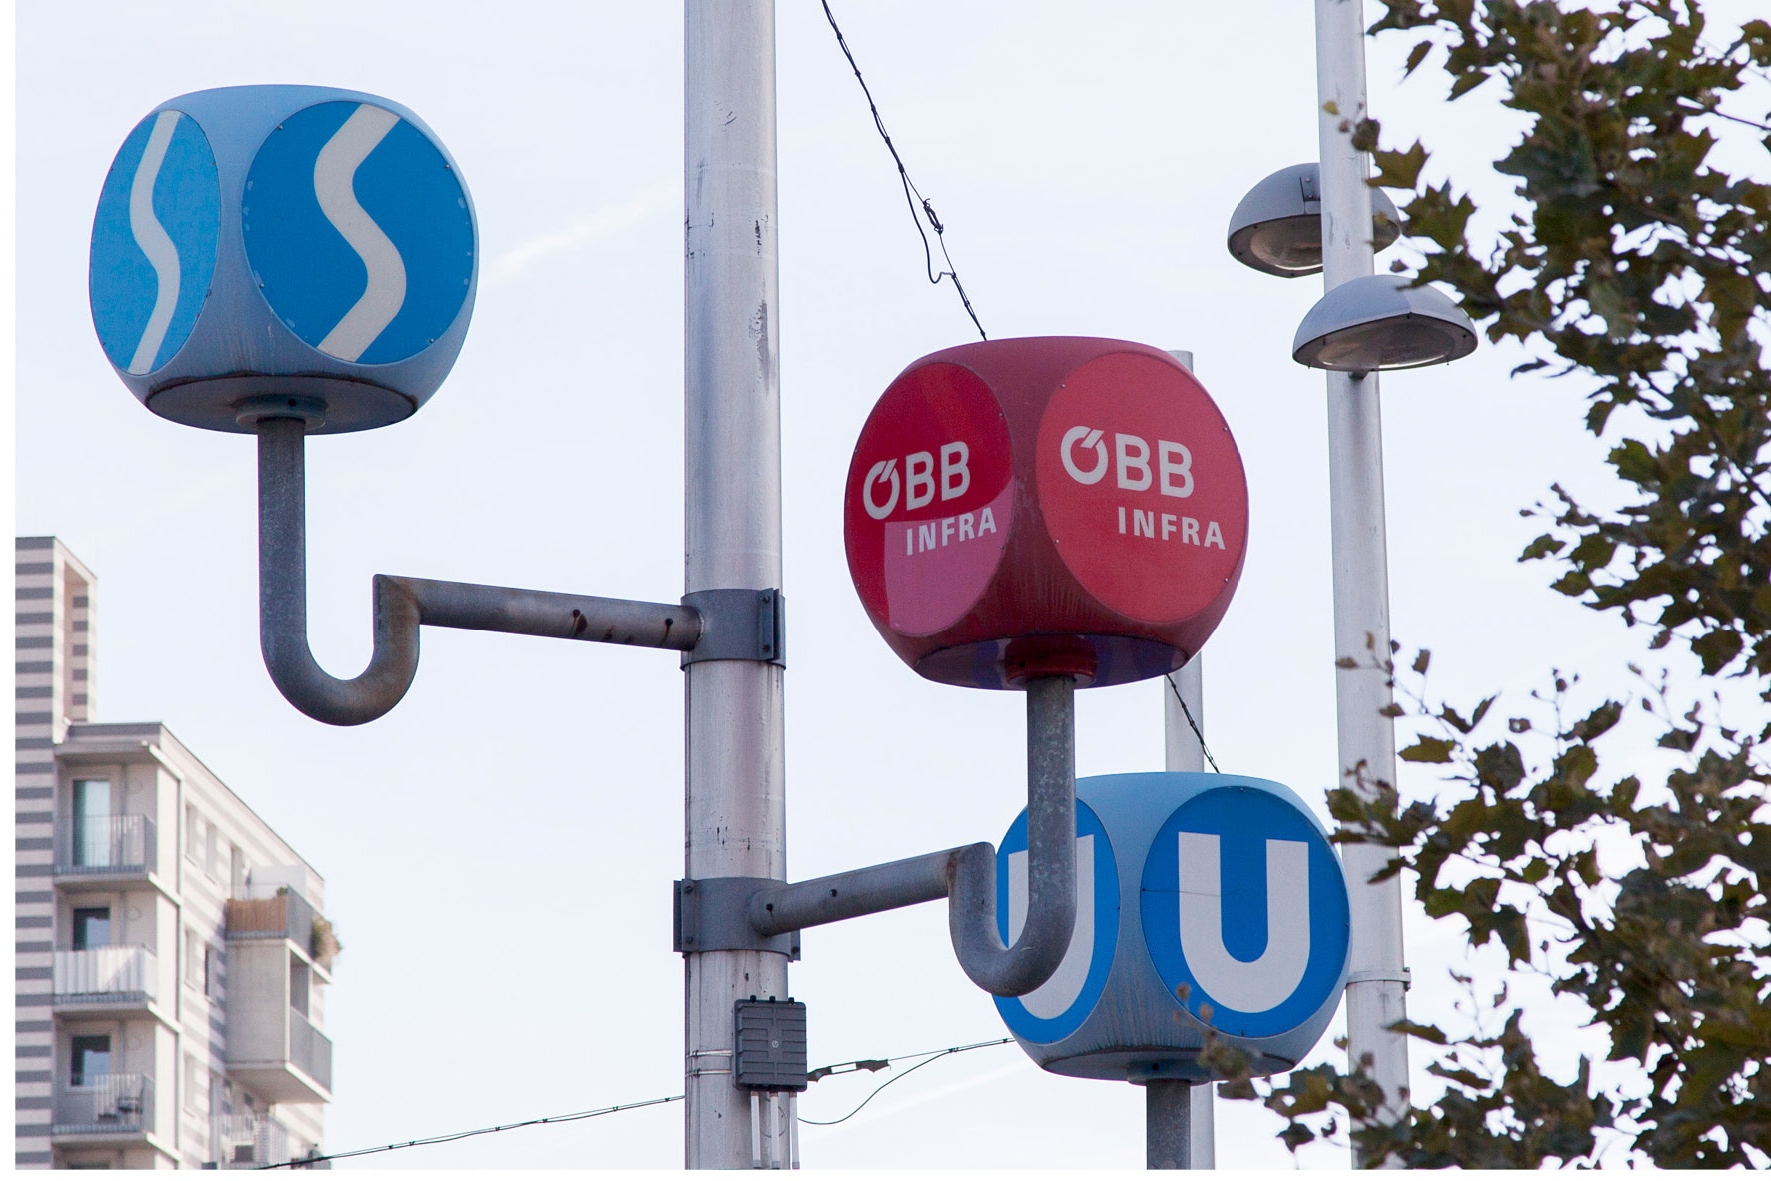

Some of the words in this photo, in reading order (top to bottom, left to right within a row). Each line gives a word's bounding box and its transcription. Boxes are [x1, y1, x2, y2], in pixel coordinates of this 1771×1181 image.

[862, 441, 970, 520] ÖBB
[1060, 425, 1195, 499] ÖBB
[906, 507, 997, 556] INFRA
[1118, 506, 1226, 550] INFRA
[1178, 831, 1311, 1014] U
